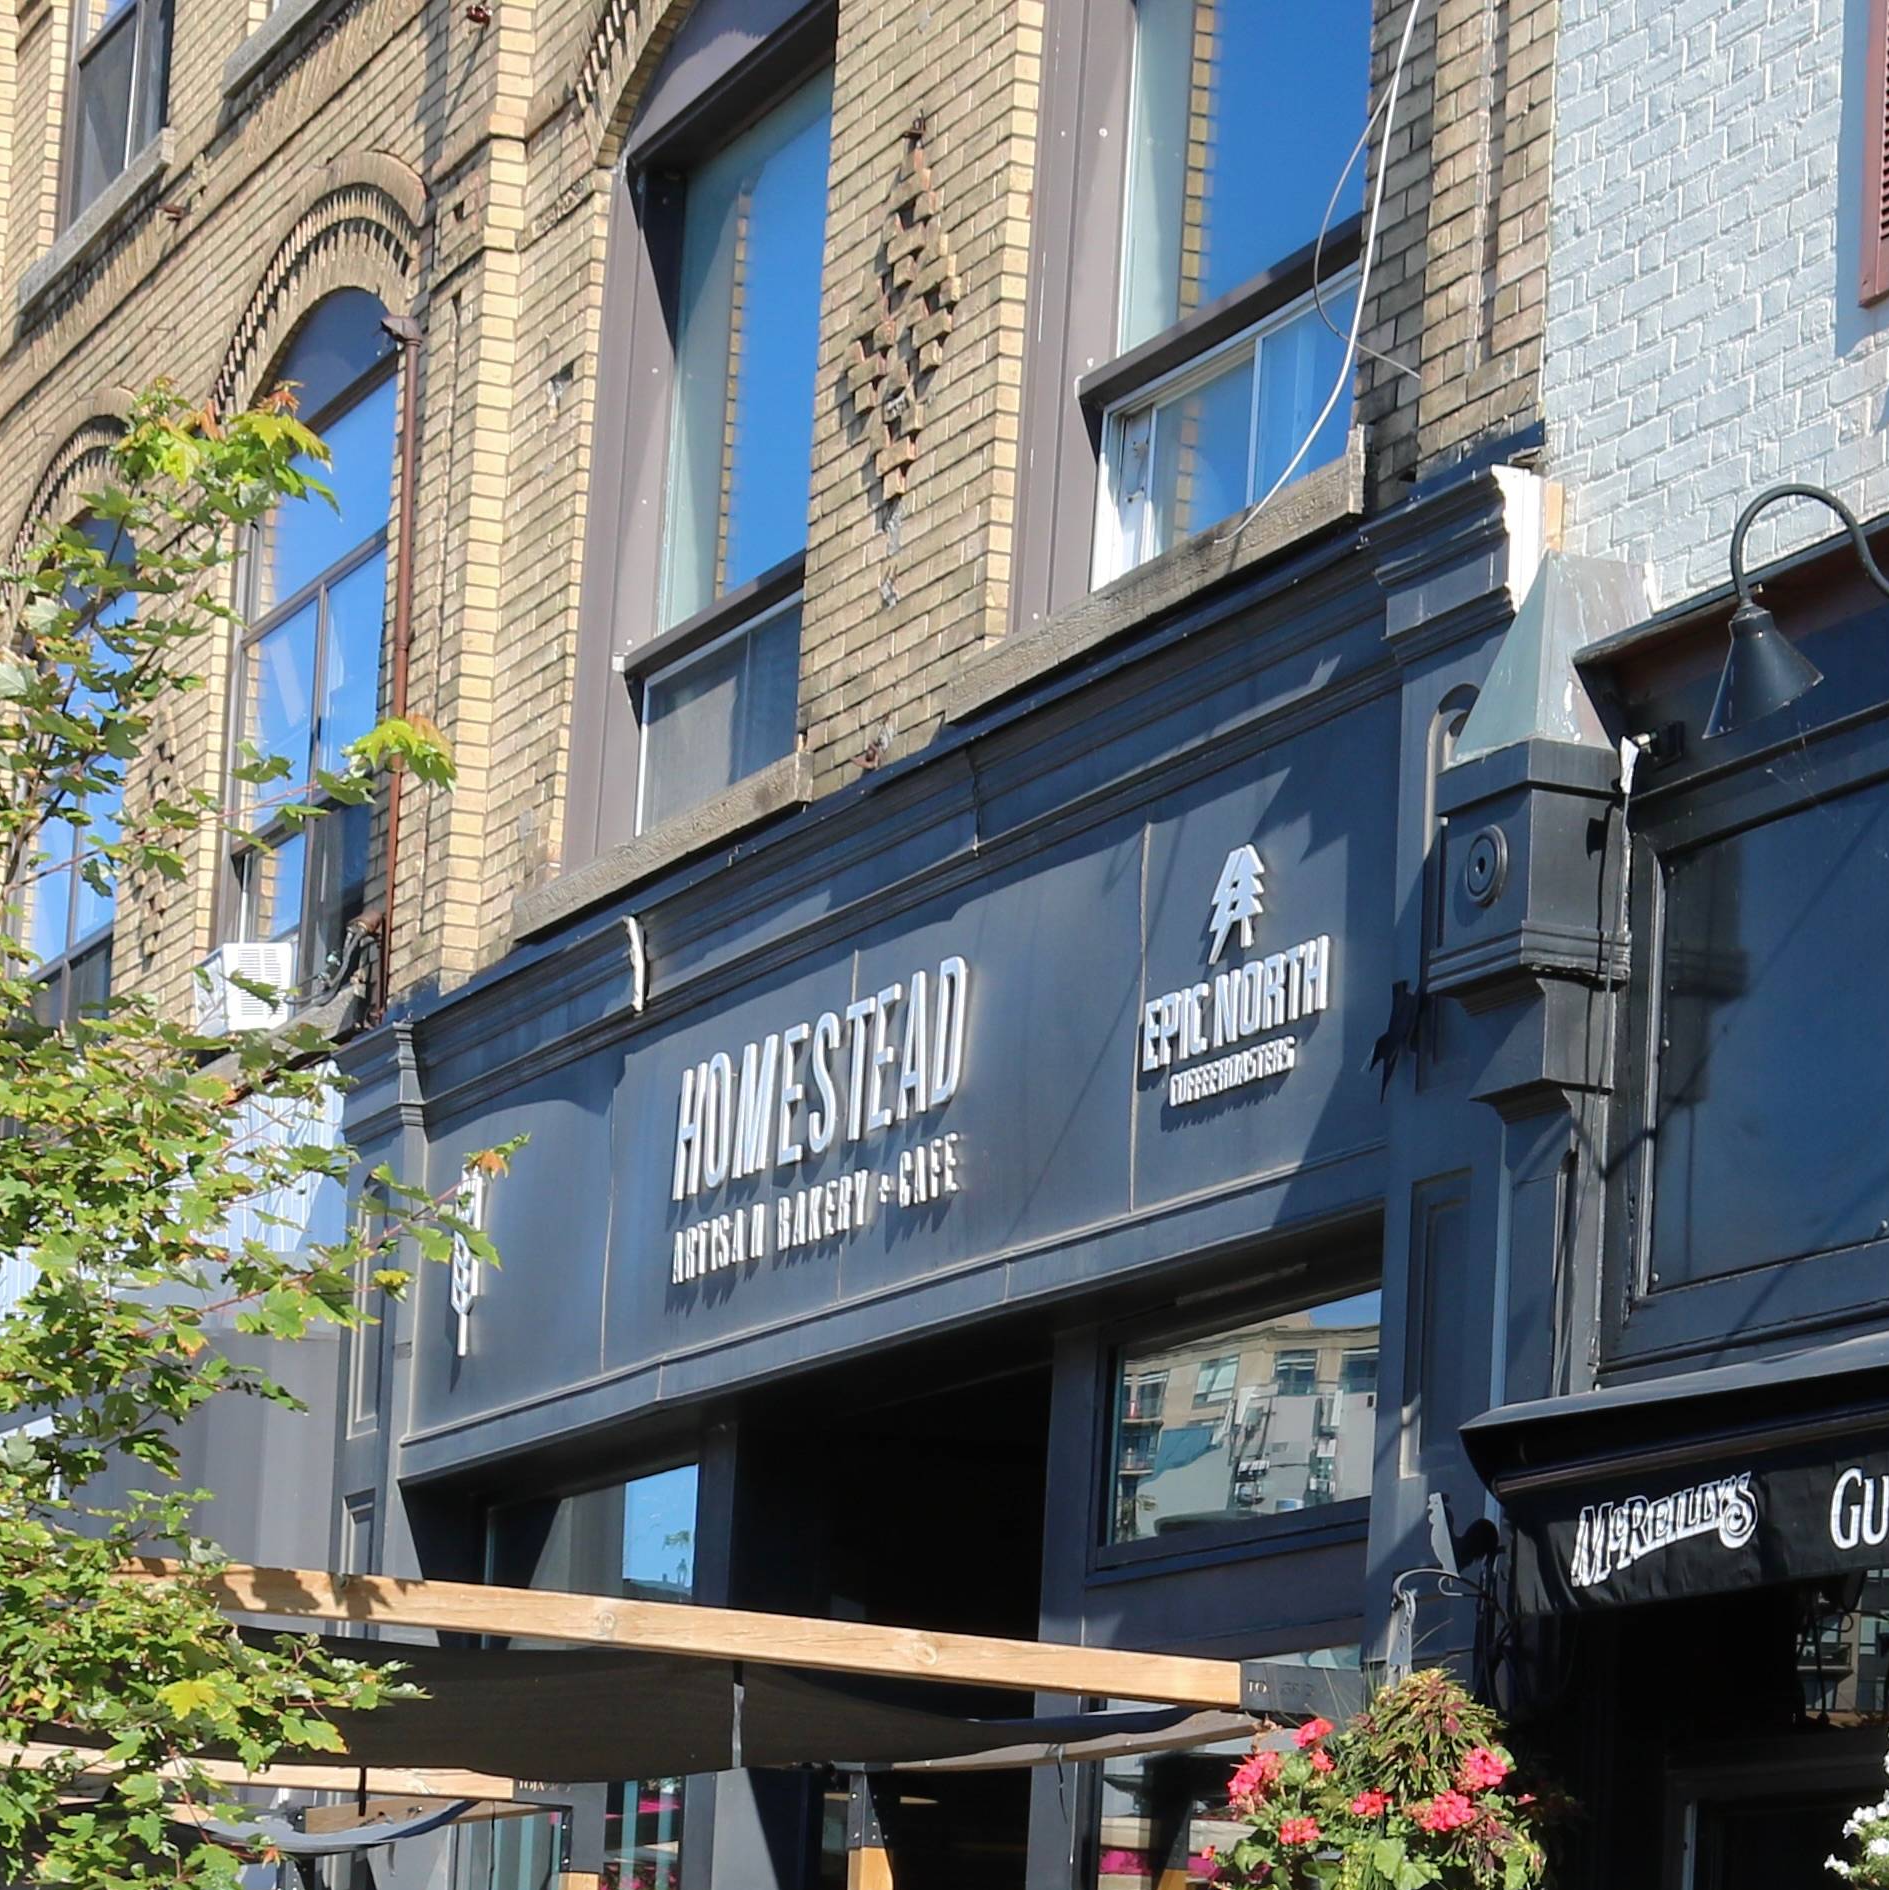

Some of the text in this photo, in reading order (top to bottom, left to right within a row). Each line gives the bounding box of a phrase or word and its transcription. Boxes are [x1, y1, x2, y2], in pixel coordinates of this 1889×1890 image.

[1143, 934, 1330, 1072] EPIC NORTH
[672, 954, 970, 1203] HOMESTEAD
[672, 1194, 767, 1286] ARTISAN
[777, 1168, 871, 1250] BAKERY
